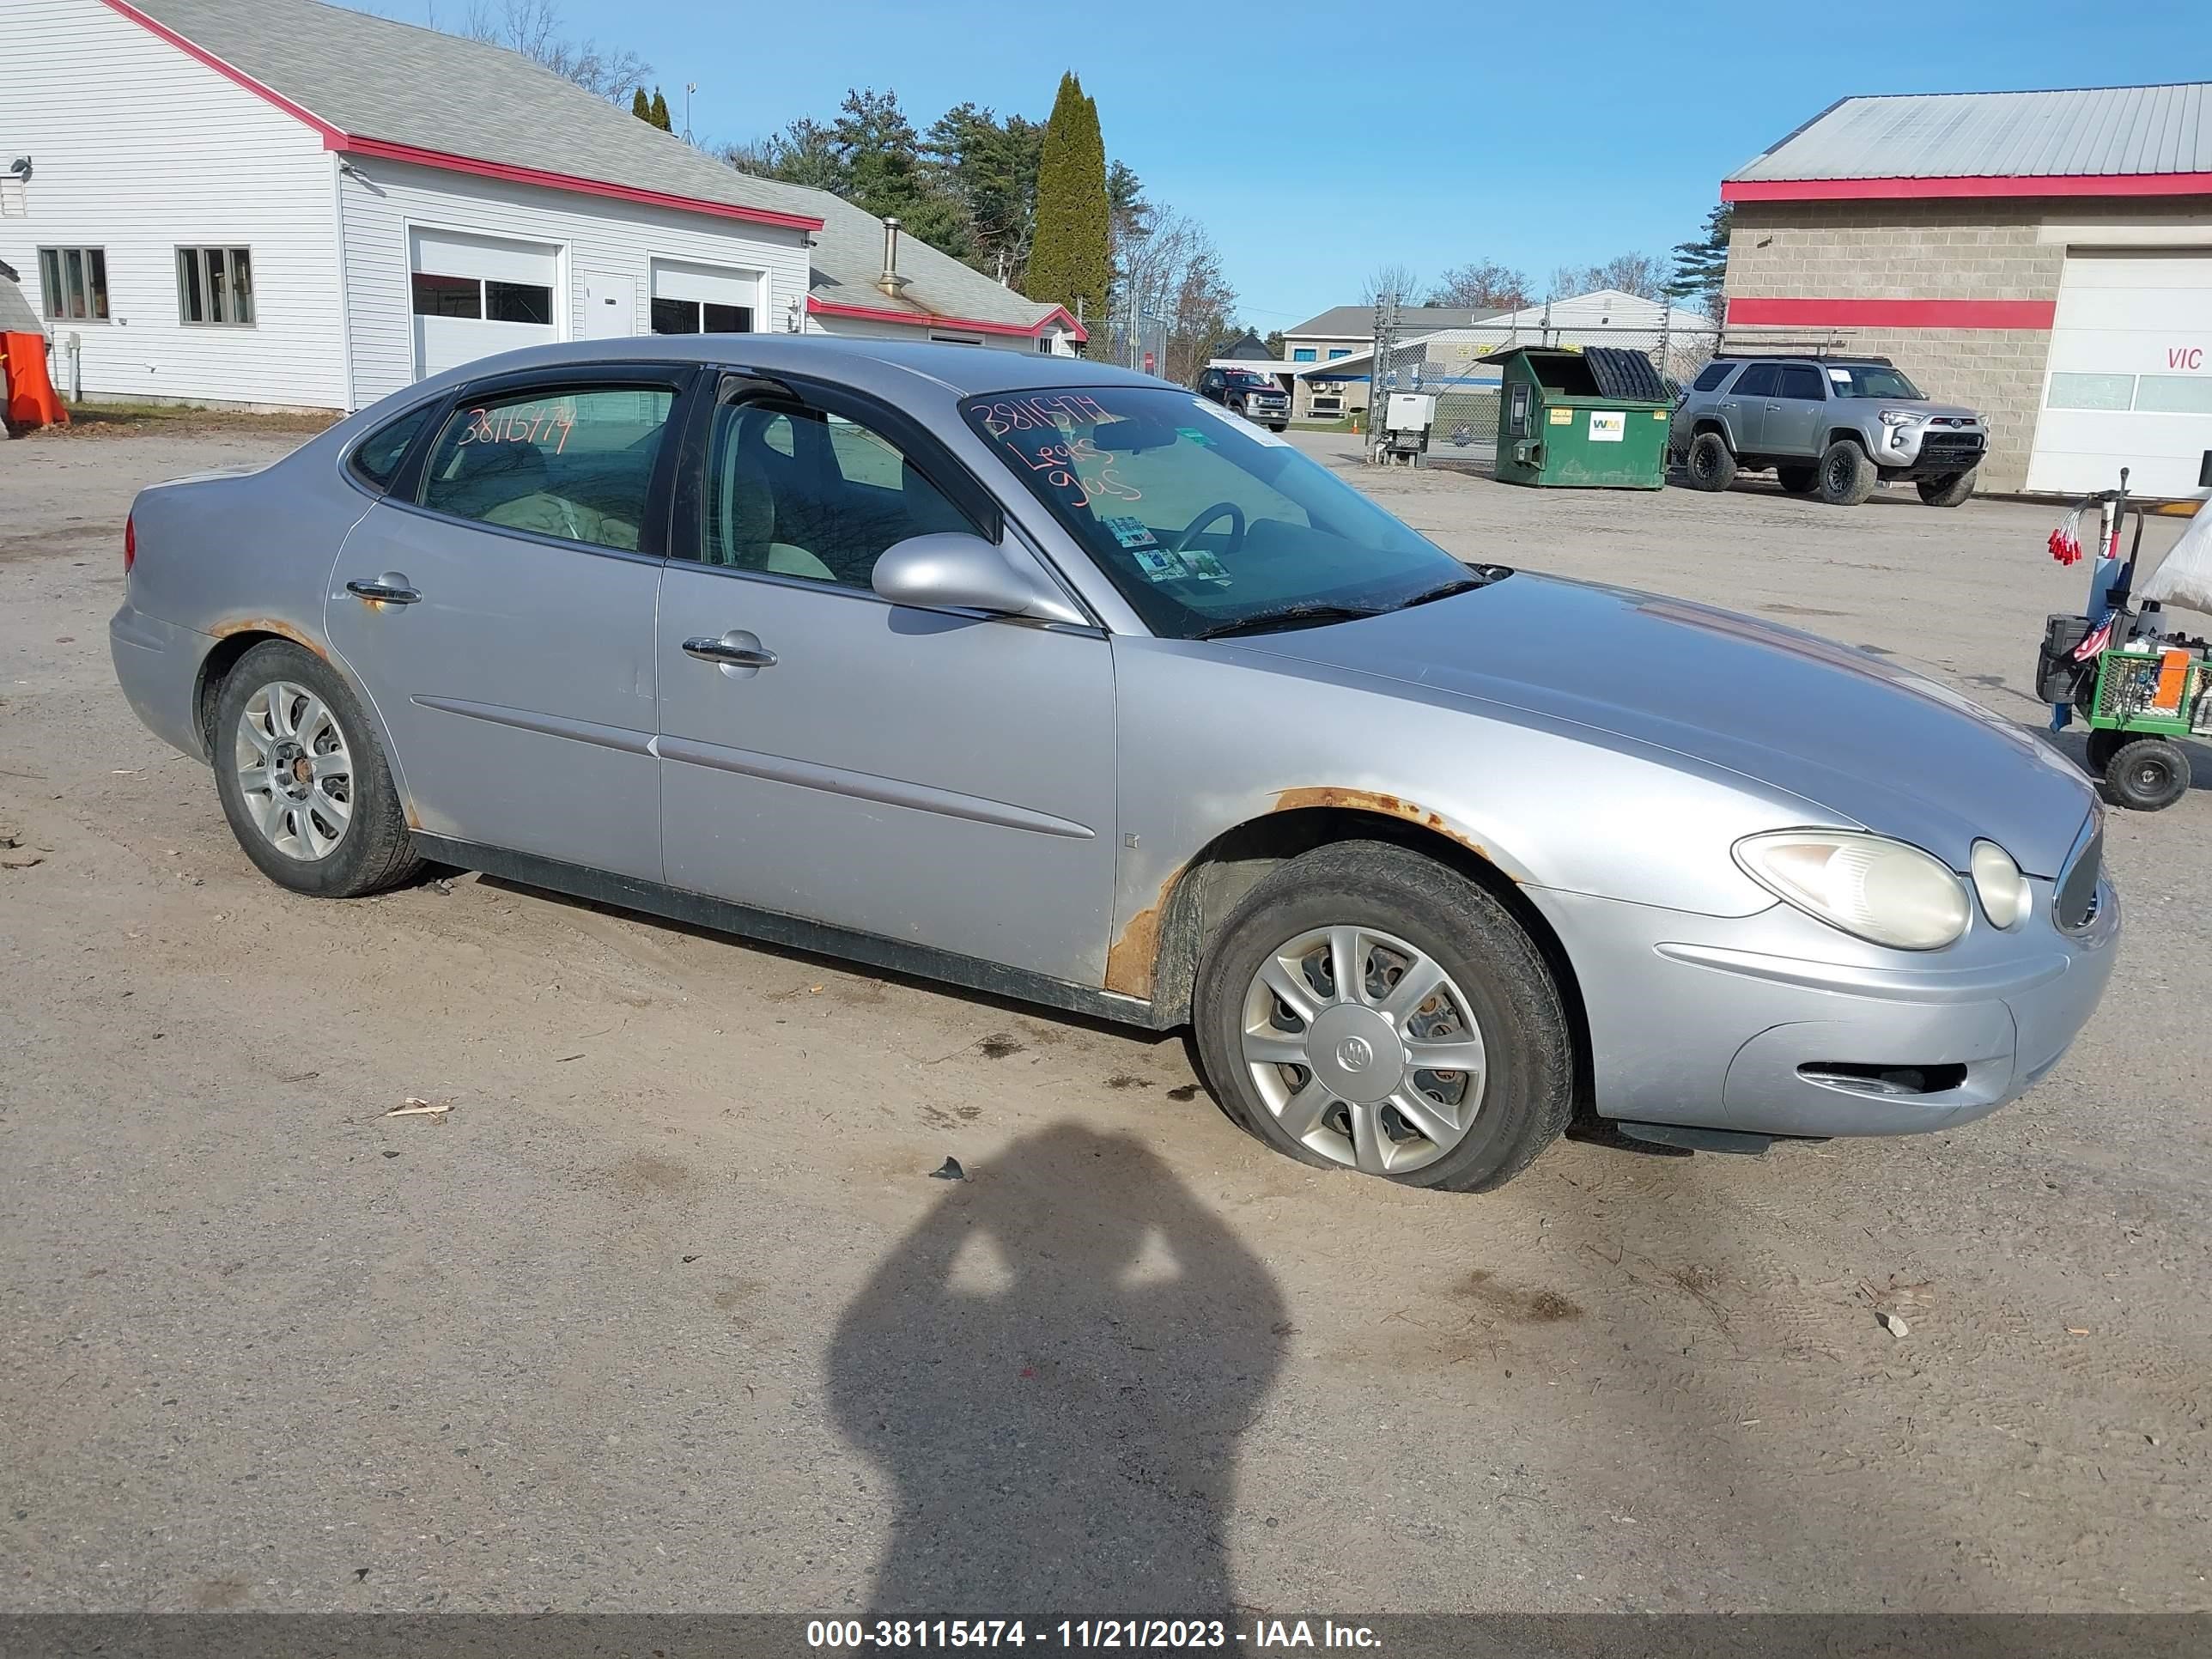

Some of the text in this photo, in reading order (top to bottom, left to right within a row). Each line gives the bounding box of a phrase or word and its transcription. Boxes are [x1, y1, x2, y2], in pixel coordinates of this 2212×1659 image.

[2169, 348, 2203, 369] VIC
[458, 405, 577, 455] 38115474
[970, 395, 1116, 435] 38115474
[1593, 419, 1621, 429] WM
[1006, 438, 1114, 471] Leaks
[1048, 469, 1142, 507] gas
